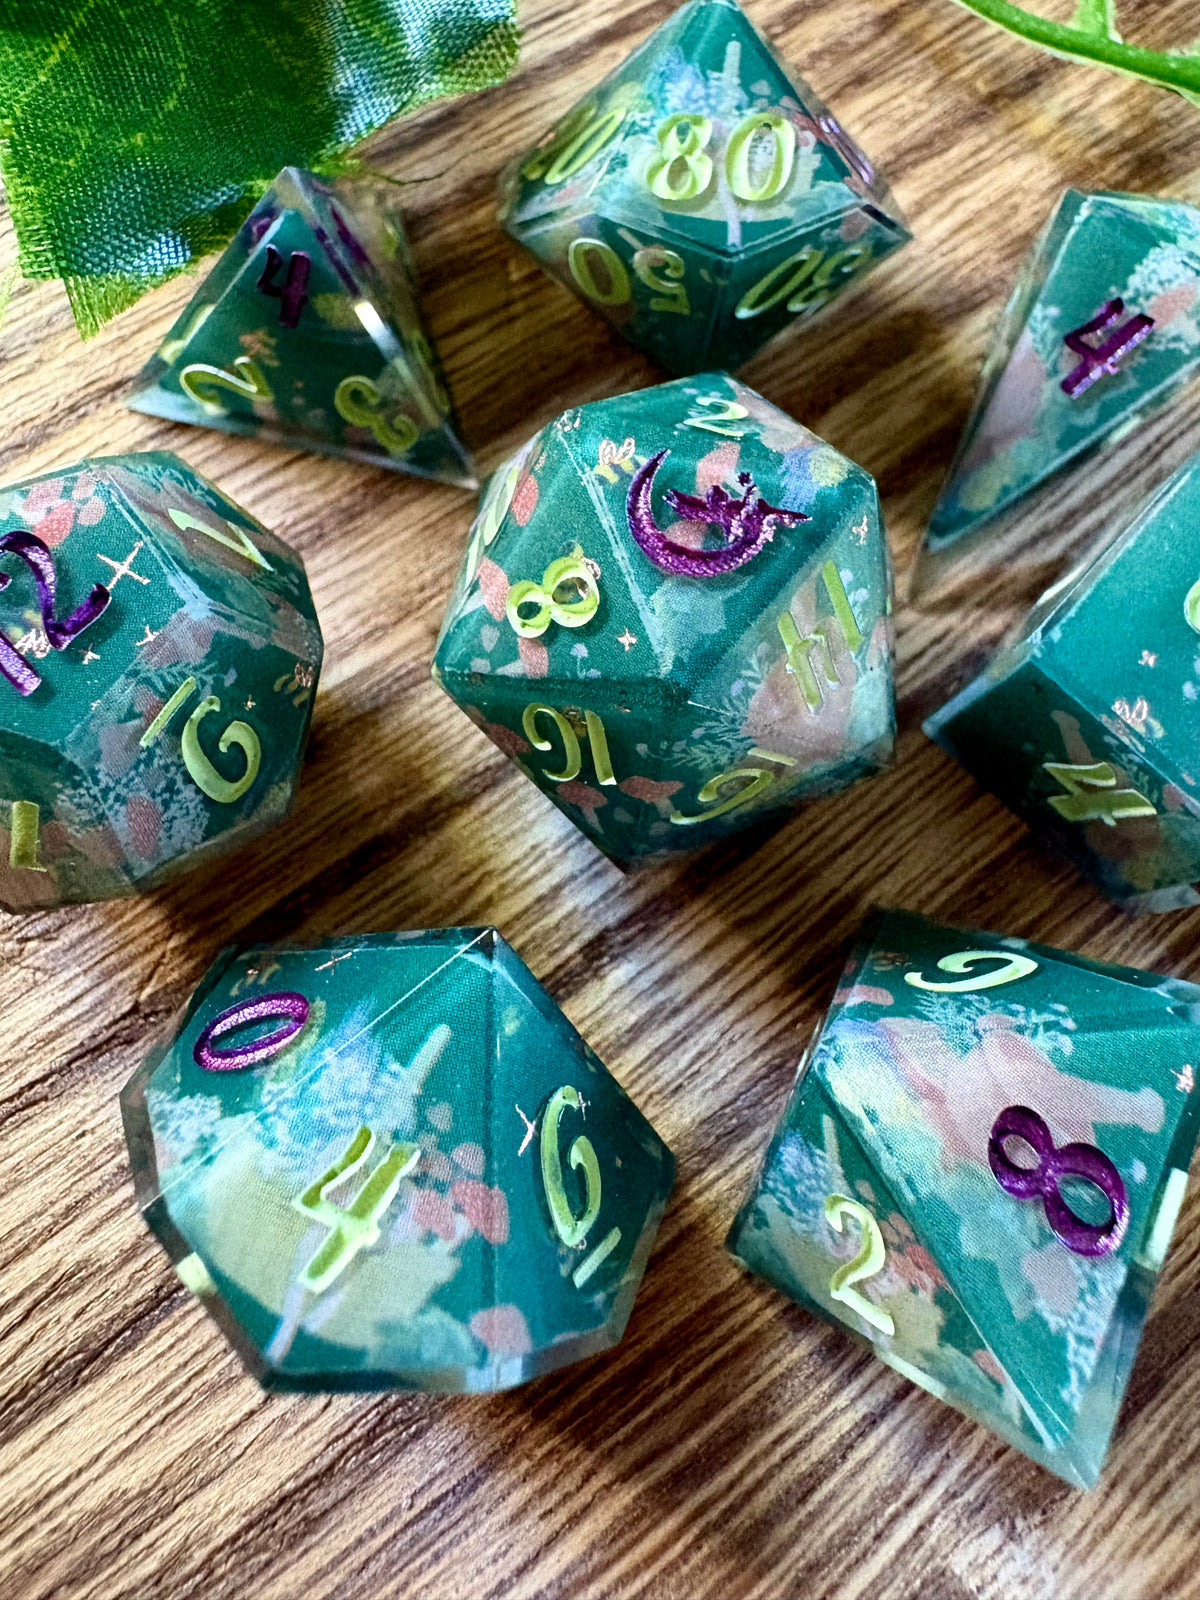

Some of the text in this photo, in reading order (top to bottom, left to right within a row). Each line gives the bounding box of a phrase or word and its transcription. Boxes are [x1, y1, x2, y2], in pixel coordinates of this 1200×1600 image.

[646, 112, 797, 202] 80
[255, 244, 312, 330] 4
[568, 237, 690, 315] 50
[179, 356, 275, 416] 2
[1060, 297, 1156, 400] 4
[682, 396, 749, 438] 2
[506, 556, 600, 638] 8
[522, 702, 617, 786] 16
[1042, 761, 1158, 827] 4
[194, 992, 309, 1071] 0
[292, 1125, 421, 1293] 4
[988, 1104, 1130, 1257] 8
[823, 1193, 895, 1336] 2
